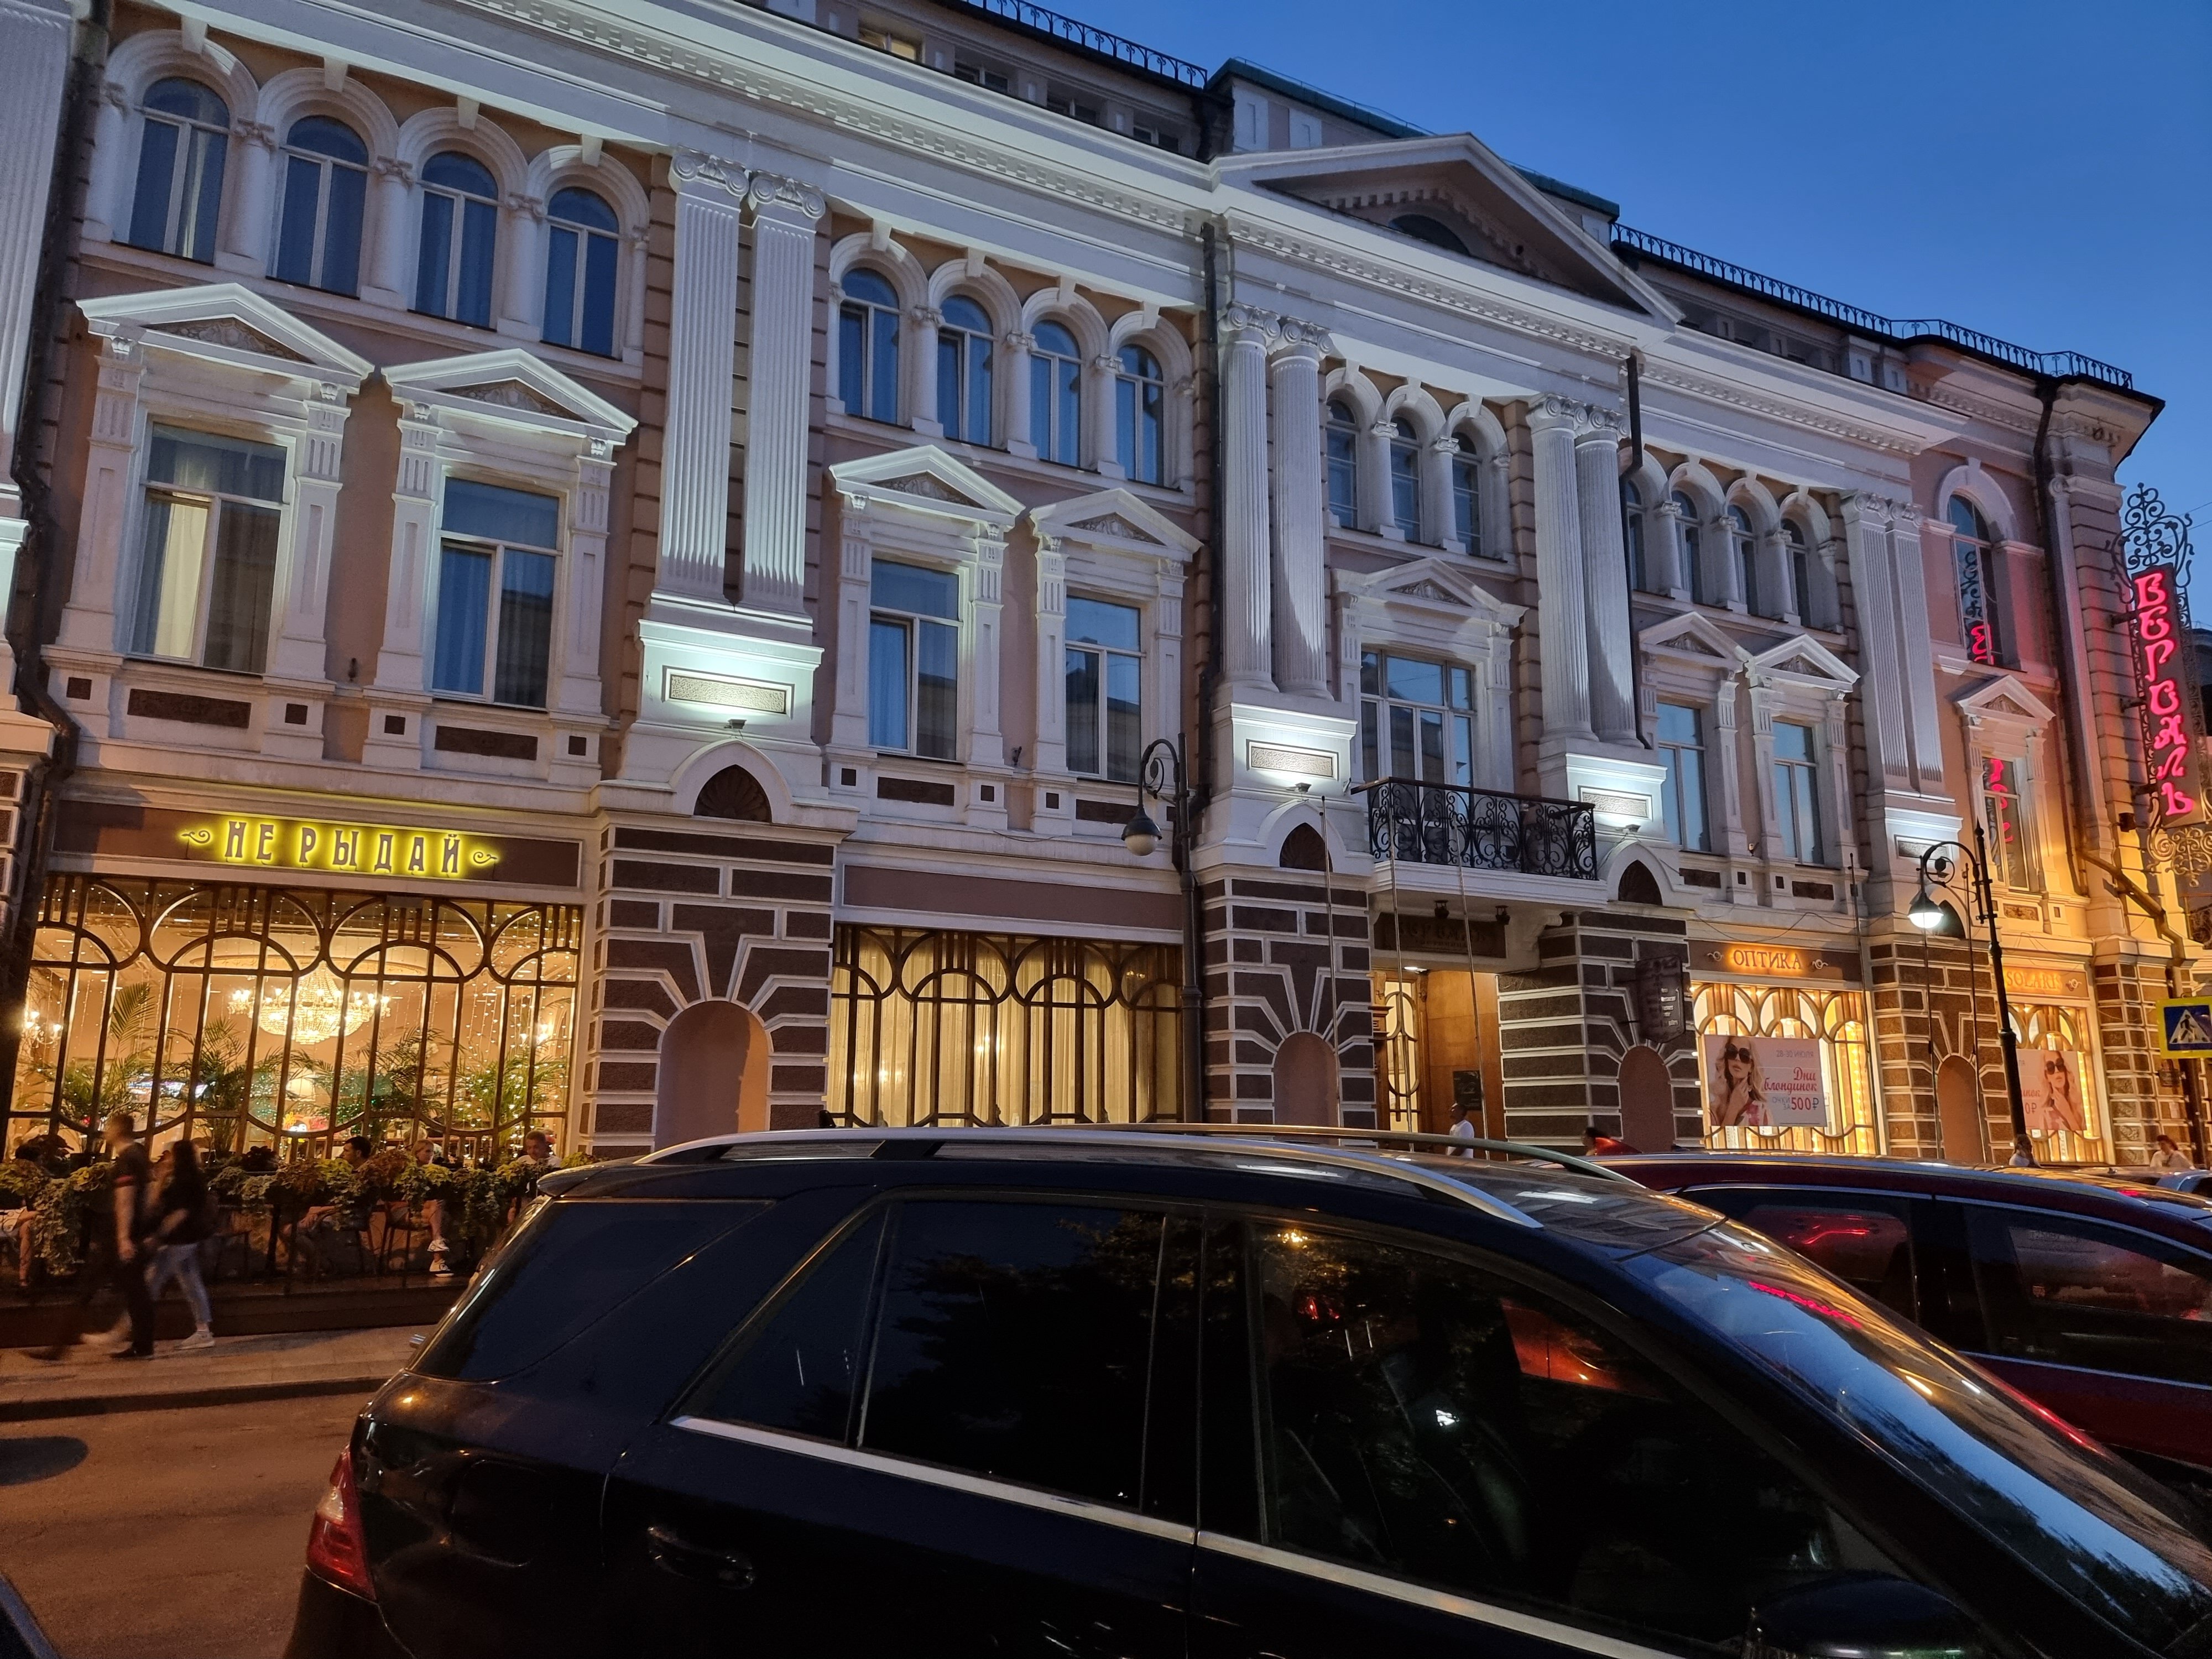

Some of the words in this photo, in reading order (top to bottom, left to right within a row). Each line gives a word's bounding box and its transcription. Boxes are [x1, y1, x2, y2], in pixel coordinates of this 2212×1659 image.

[2134, 573, 2194, 816] ВЕРСАЛЬ
[225, 821, 275, 860] НЕ
[299, 827, 461, 873] РЫДАЙ
[1733, 950, 1803, 969] ОПТИКА
[2006, 972, 2061, 990] SOLARIS
[1793, 1067, 1816, 1081] Дни
[1764, 1078, 1817, 1095] блондинок
